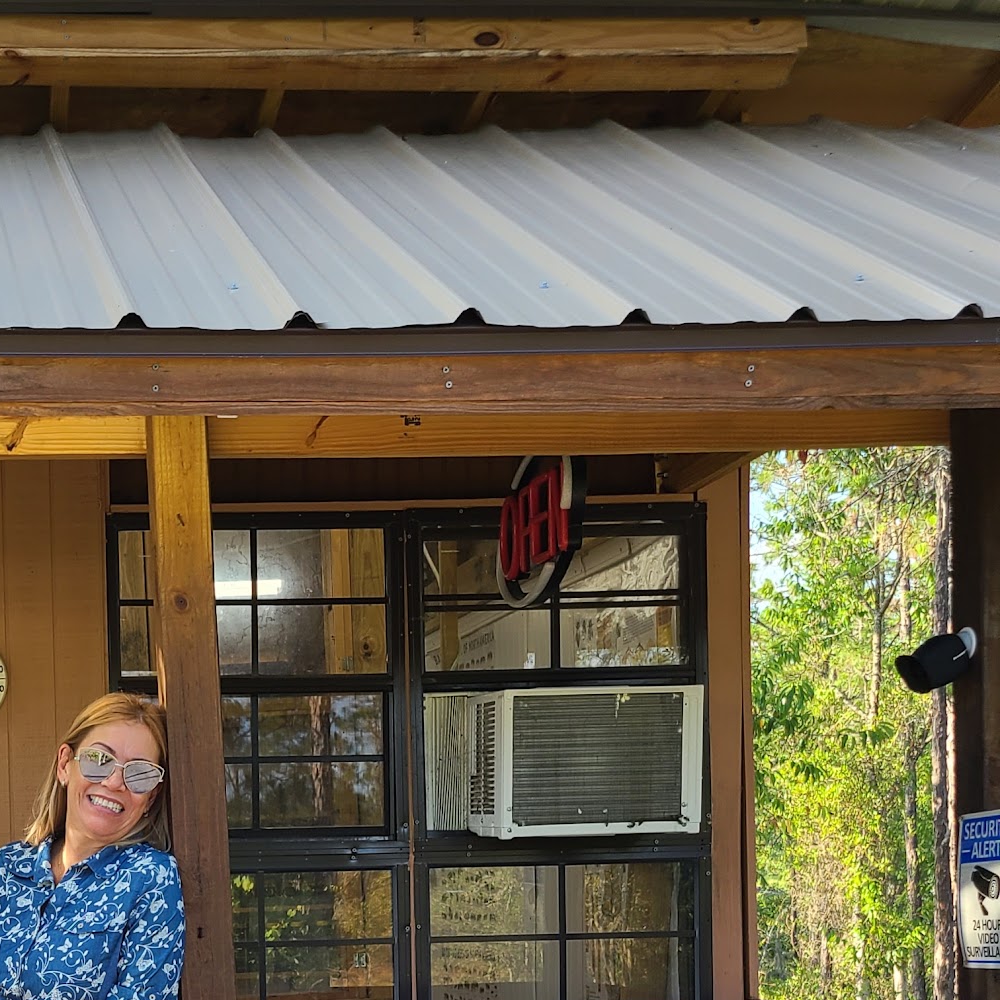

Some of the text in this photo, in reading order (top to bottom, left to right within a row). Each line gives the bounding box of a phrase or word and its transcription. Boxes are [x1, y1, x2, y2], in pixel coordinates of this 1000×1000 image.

[971, 840, 1000, 859] ALERT
[972, 919, 981, 931] 24
[977, 932, 999, 944] VIDEO
